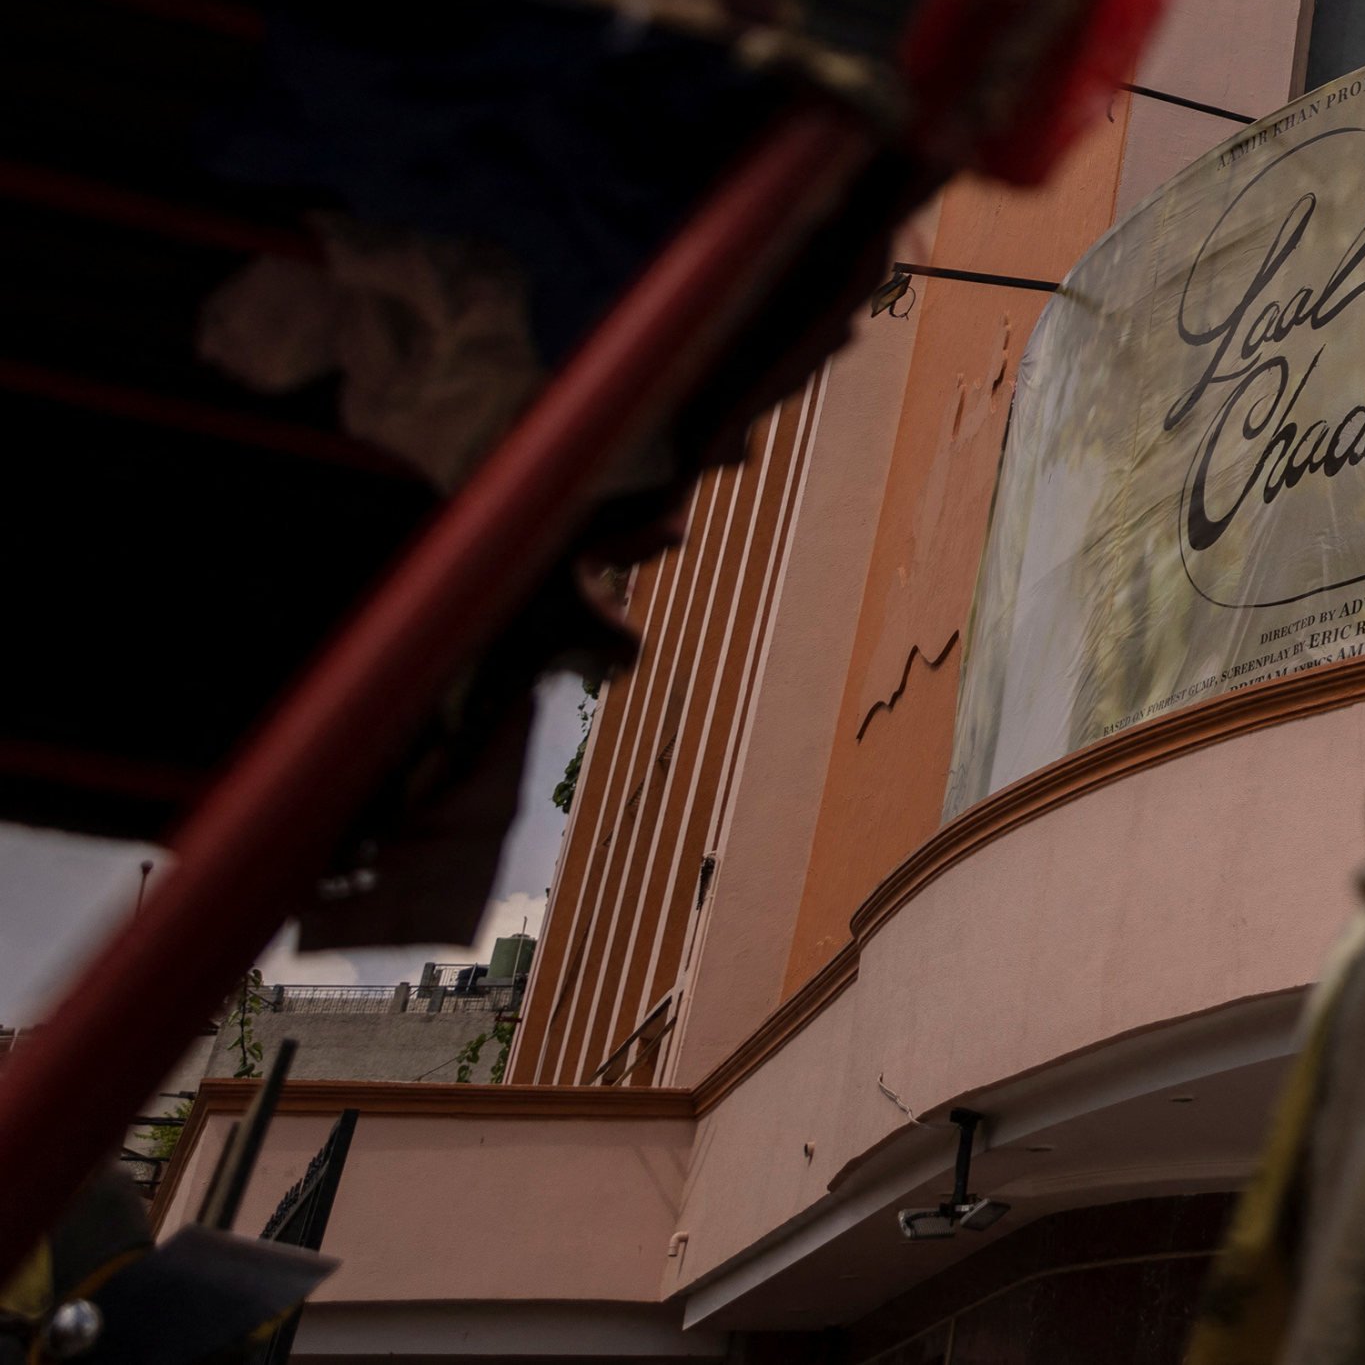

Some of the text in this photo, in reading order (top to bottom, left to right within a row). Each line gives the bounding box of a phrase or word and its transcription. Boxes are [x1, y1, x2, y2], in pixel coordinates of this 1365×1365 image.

[1217, 125, 1270, 171] AAMIR
[1272, 99, 1322, 139] KHAN
[1220, 645, 1292, 683] SCREENPLAY
[1292, 640, 1307, 657] BY
[1309, 623, 1352, 650] ERIC
[1260, 614, 1316, 646] DIRECTED
[1318, 609, 1337, 624] BY
